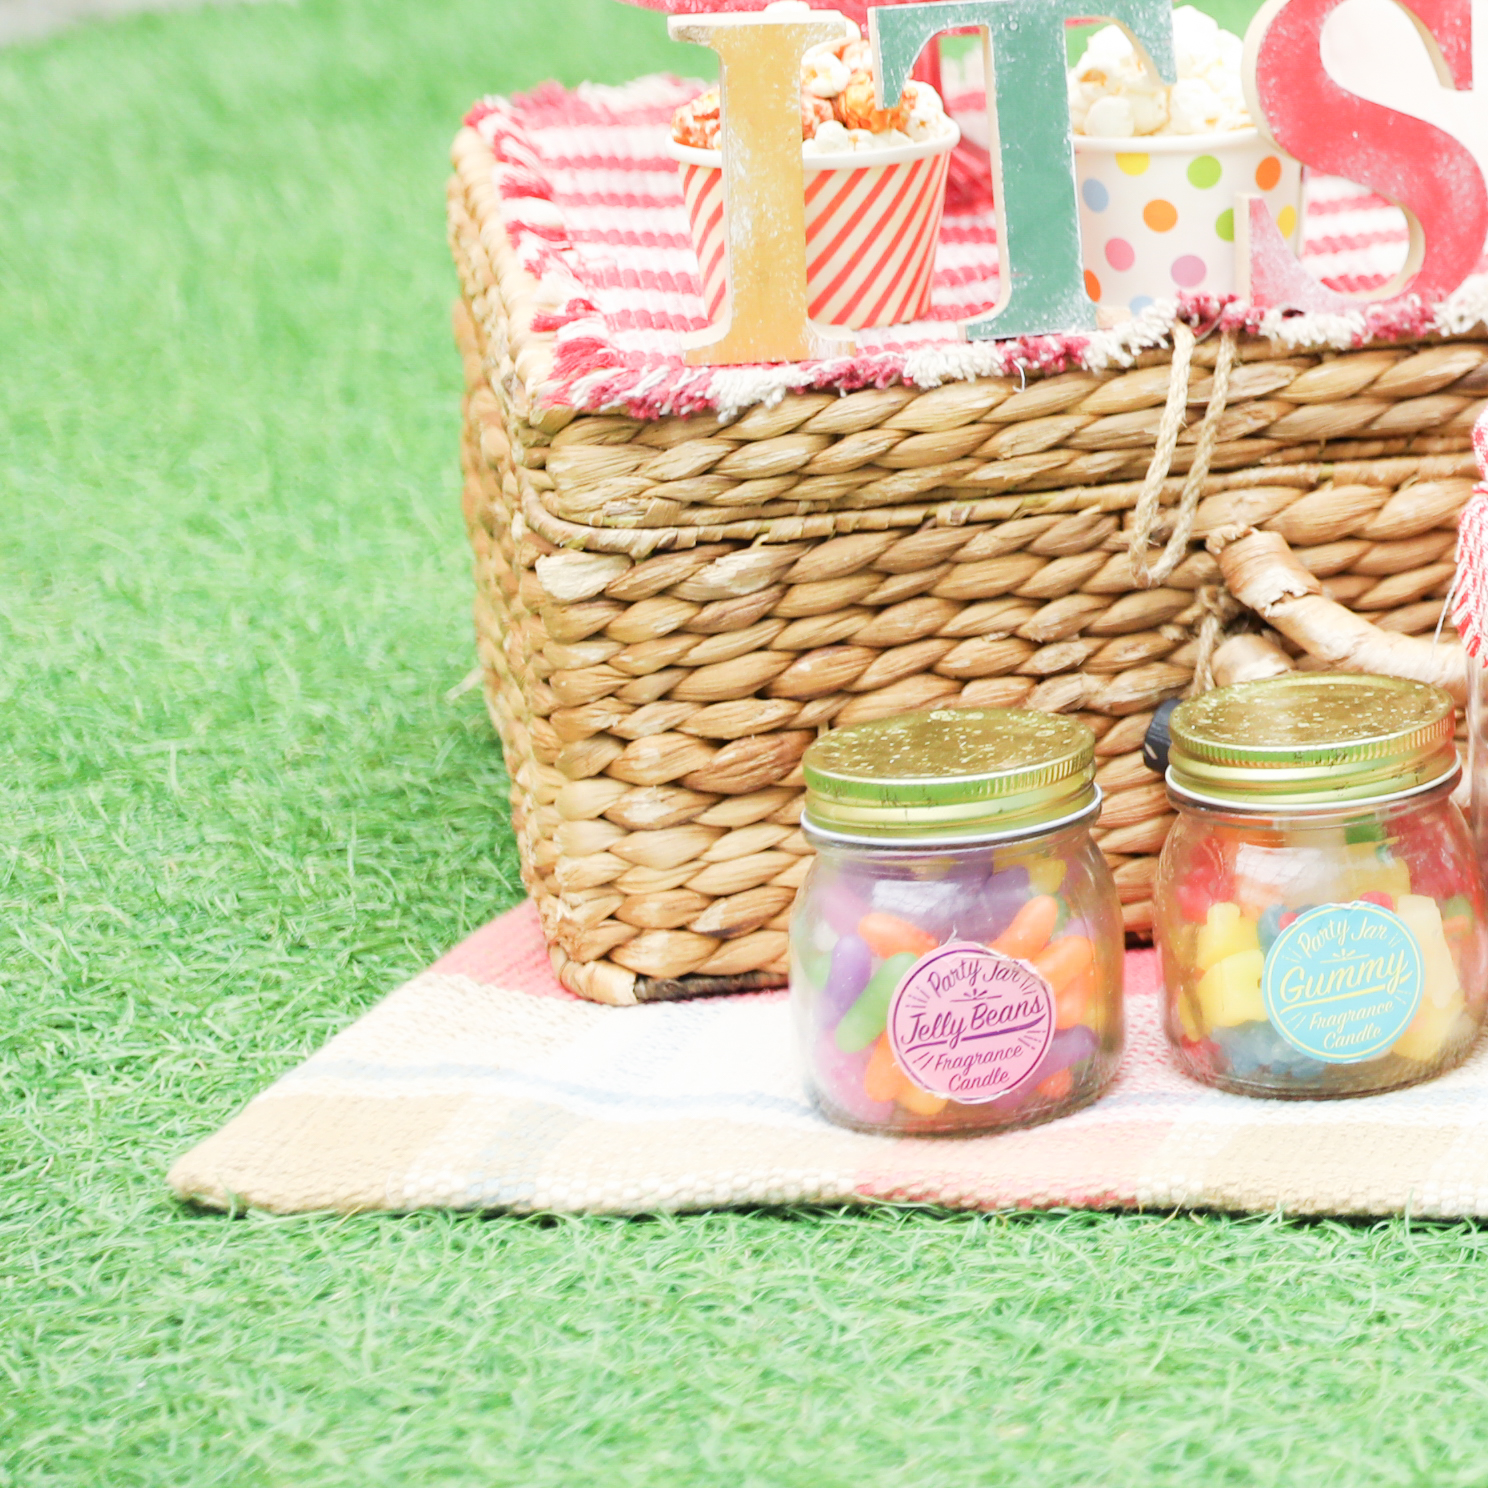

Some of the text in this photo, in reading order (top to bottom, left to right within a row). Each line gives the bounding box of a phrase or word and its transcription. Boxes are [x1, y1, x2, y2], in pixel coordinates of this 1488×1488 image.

[1297, 917, 1388, 959] Party Jar
[927, 959, 1022, 998] Party Jar
[1279, 949, 1409, 1003] Gummy
[901, 994, 1045, 1050] Jelly Beans
[1309, 1000, 1395, 1034] Fragrance
[1323, 1022, 1382, 1049] Candle
[934, 1044, 1024, 1076] Fragrance
[948, 1067, 1010, 1092] Candle
